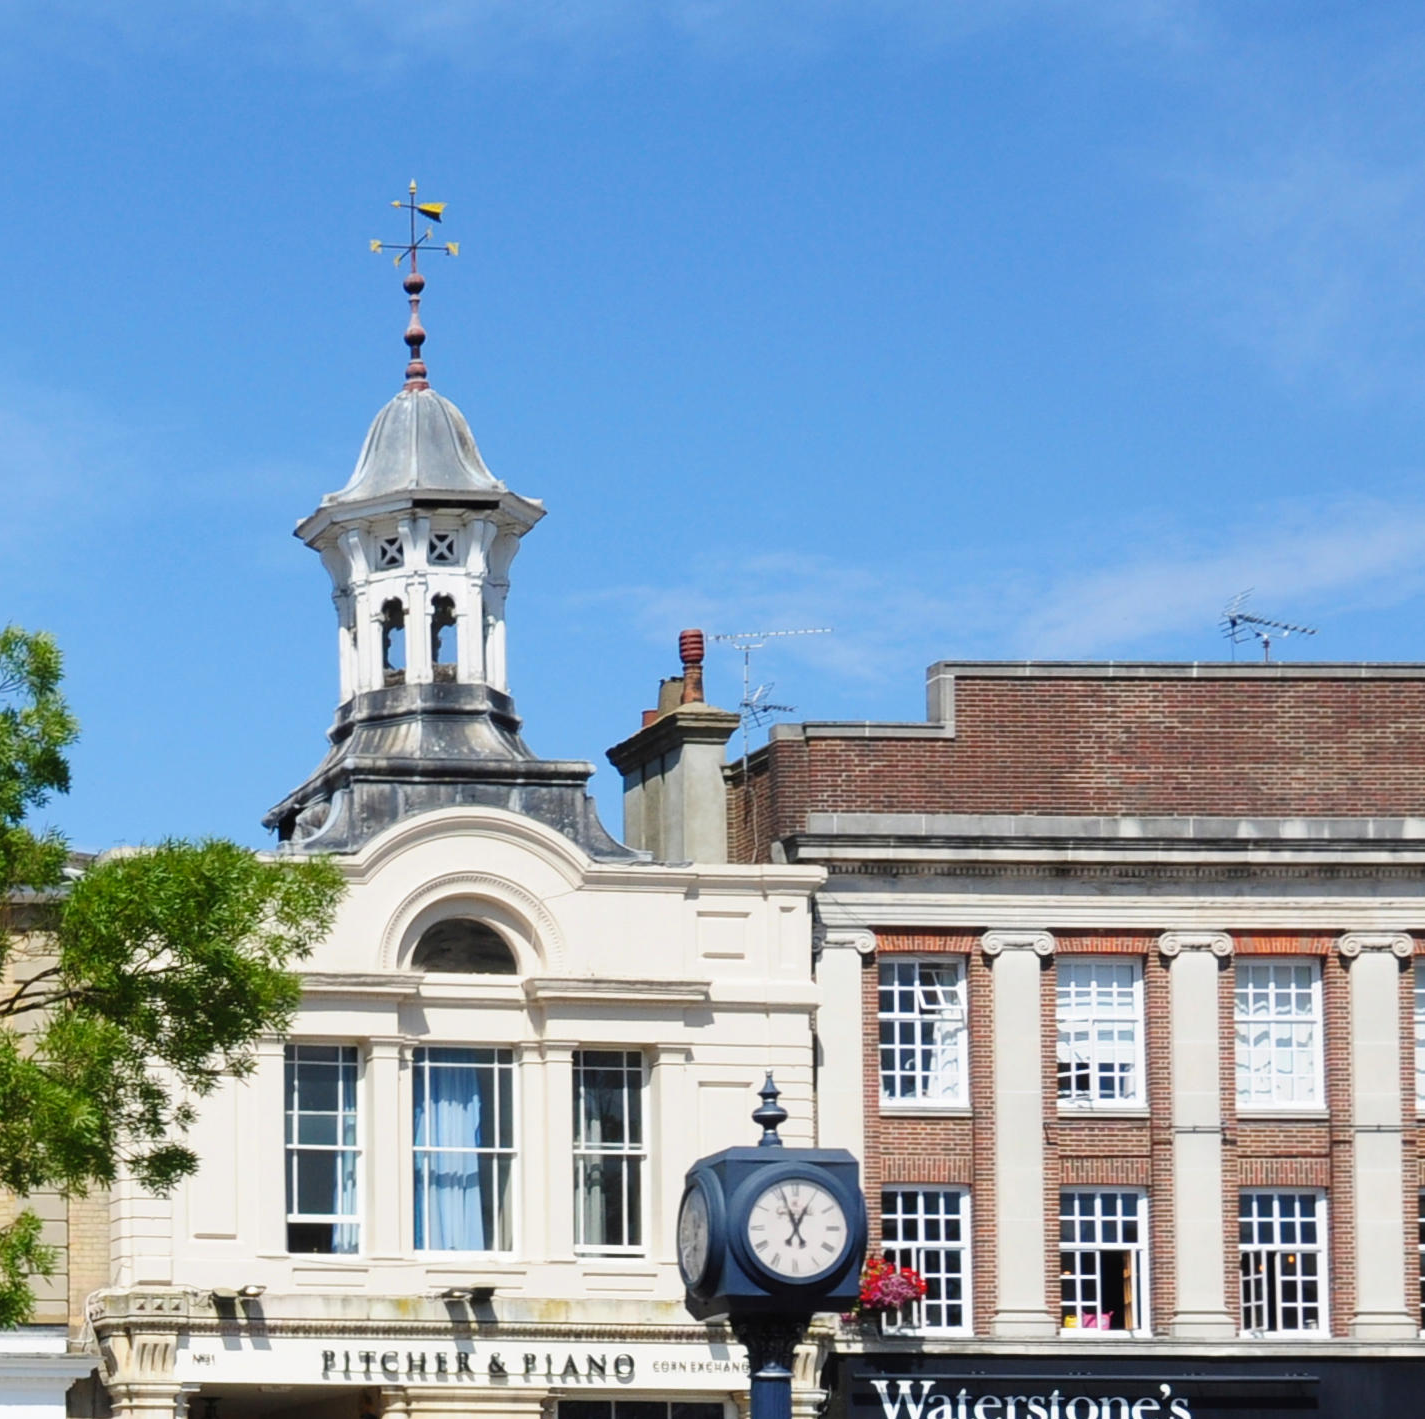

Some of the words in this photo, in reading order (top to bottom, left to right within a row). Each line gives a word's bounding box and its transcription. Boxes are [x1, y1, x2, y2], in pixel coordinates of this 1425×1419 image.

[322, 1350, 475, 1374] PITCHER
[488, 1352, 508, 1377] &
[523, 1353, 635, 1377] PIANO
[653, 1361, 687, 1373] CORN
[690, 1361, 749, 1373] EXCHANG
